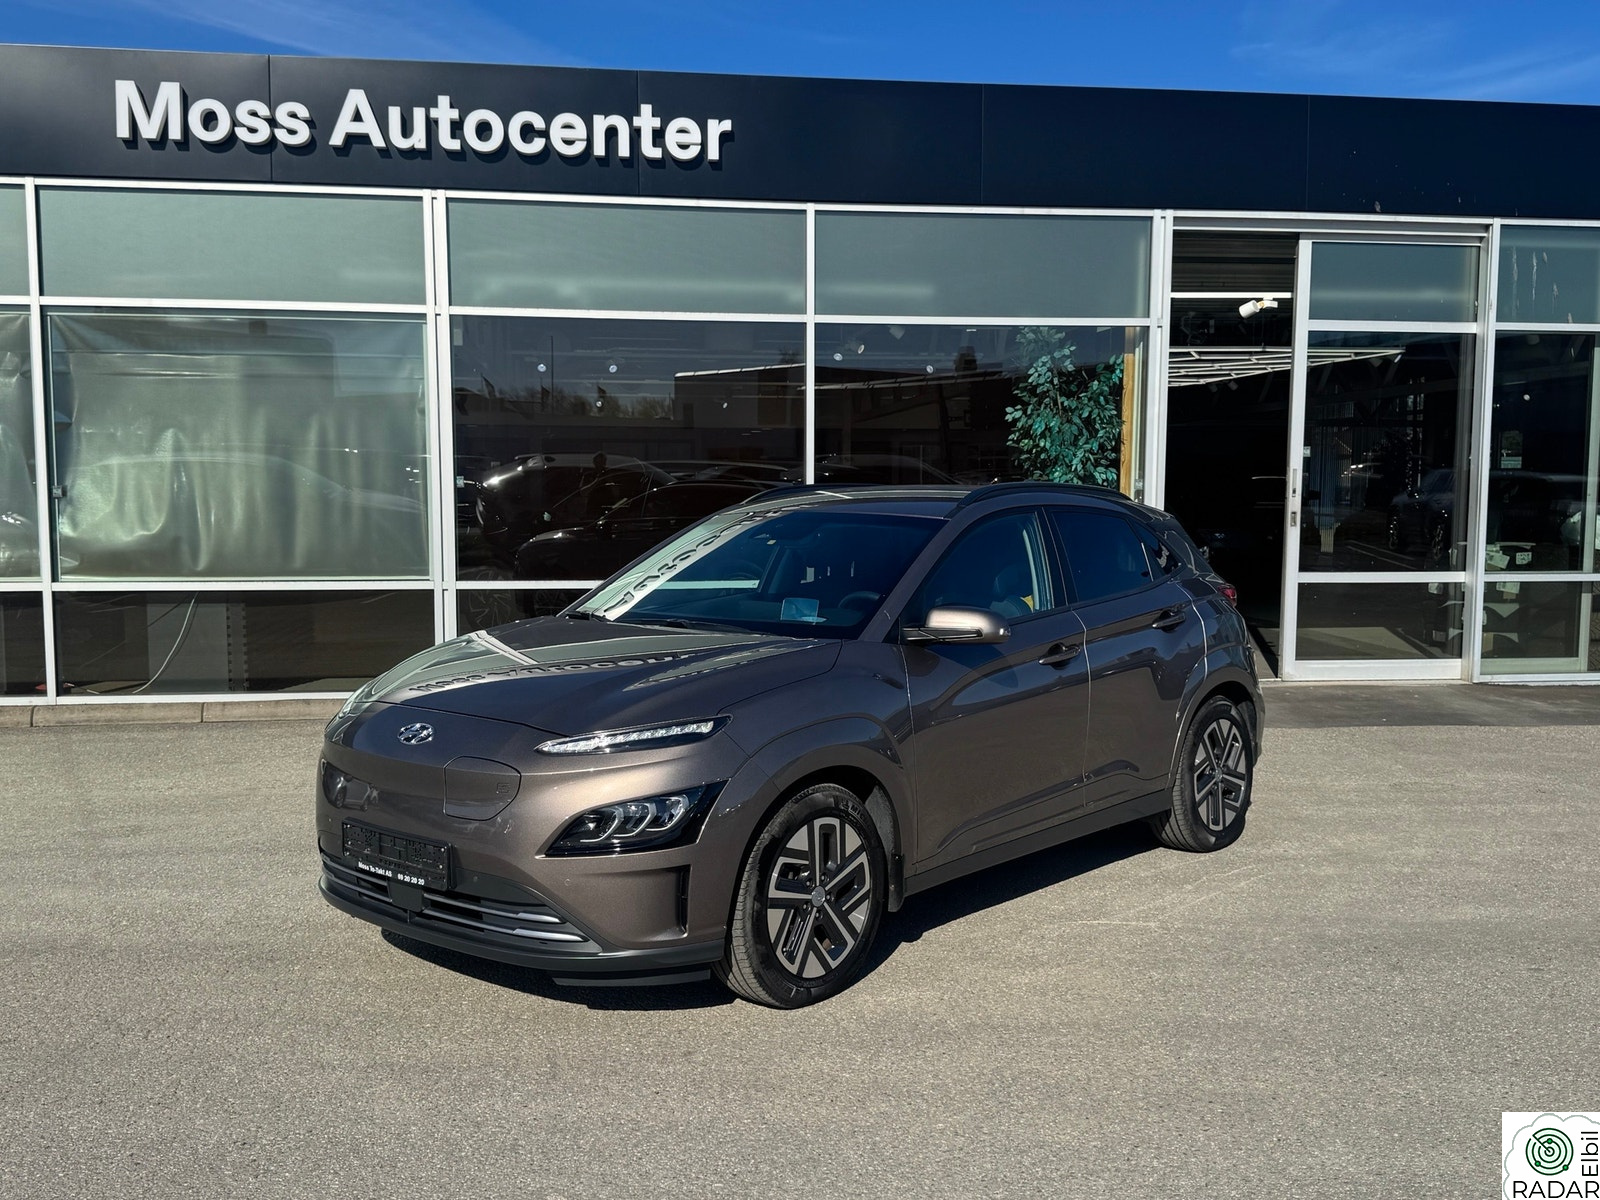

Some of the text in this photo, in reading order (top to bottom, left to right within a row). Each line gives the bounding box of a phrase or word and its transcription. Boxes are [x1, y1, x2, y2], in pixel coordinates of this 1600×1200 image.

[114, 79, 733, 162] Moss Autocenter
[385, 869, 392, 877] AS
[410, 876, 418, 884] 20
[417, 878, 425, 886] 20
